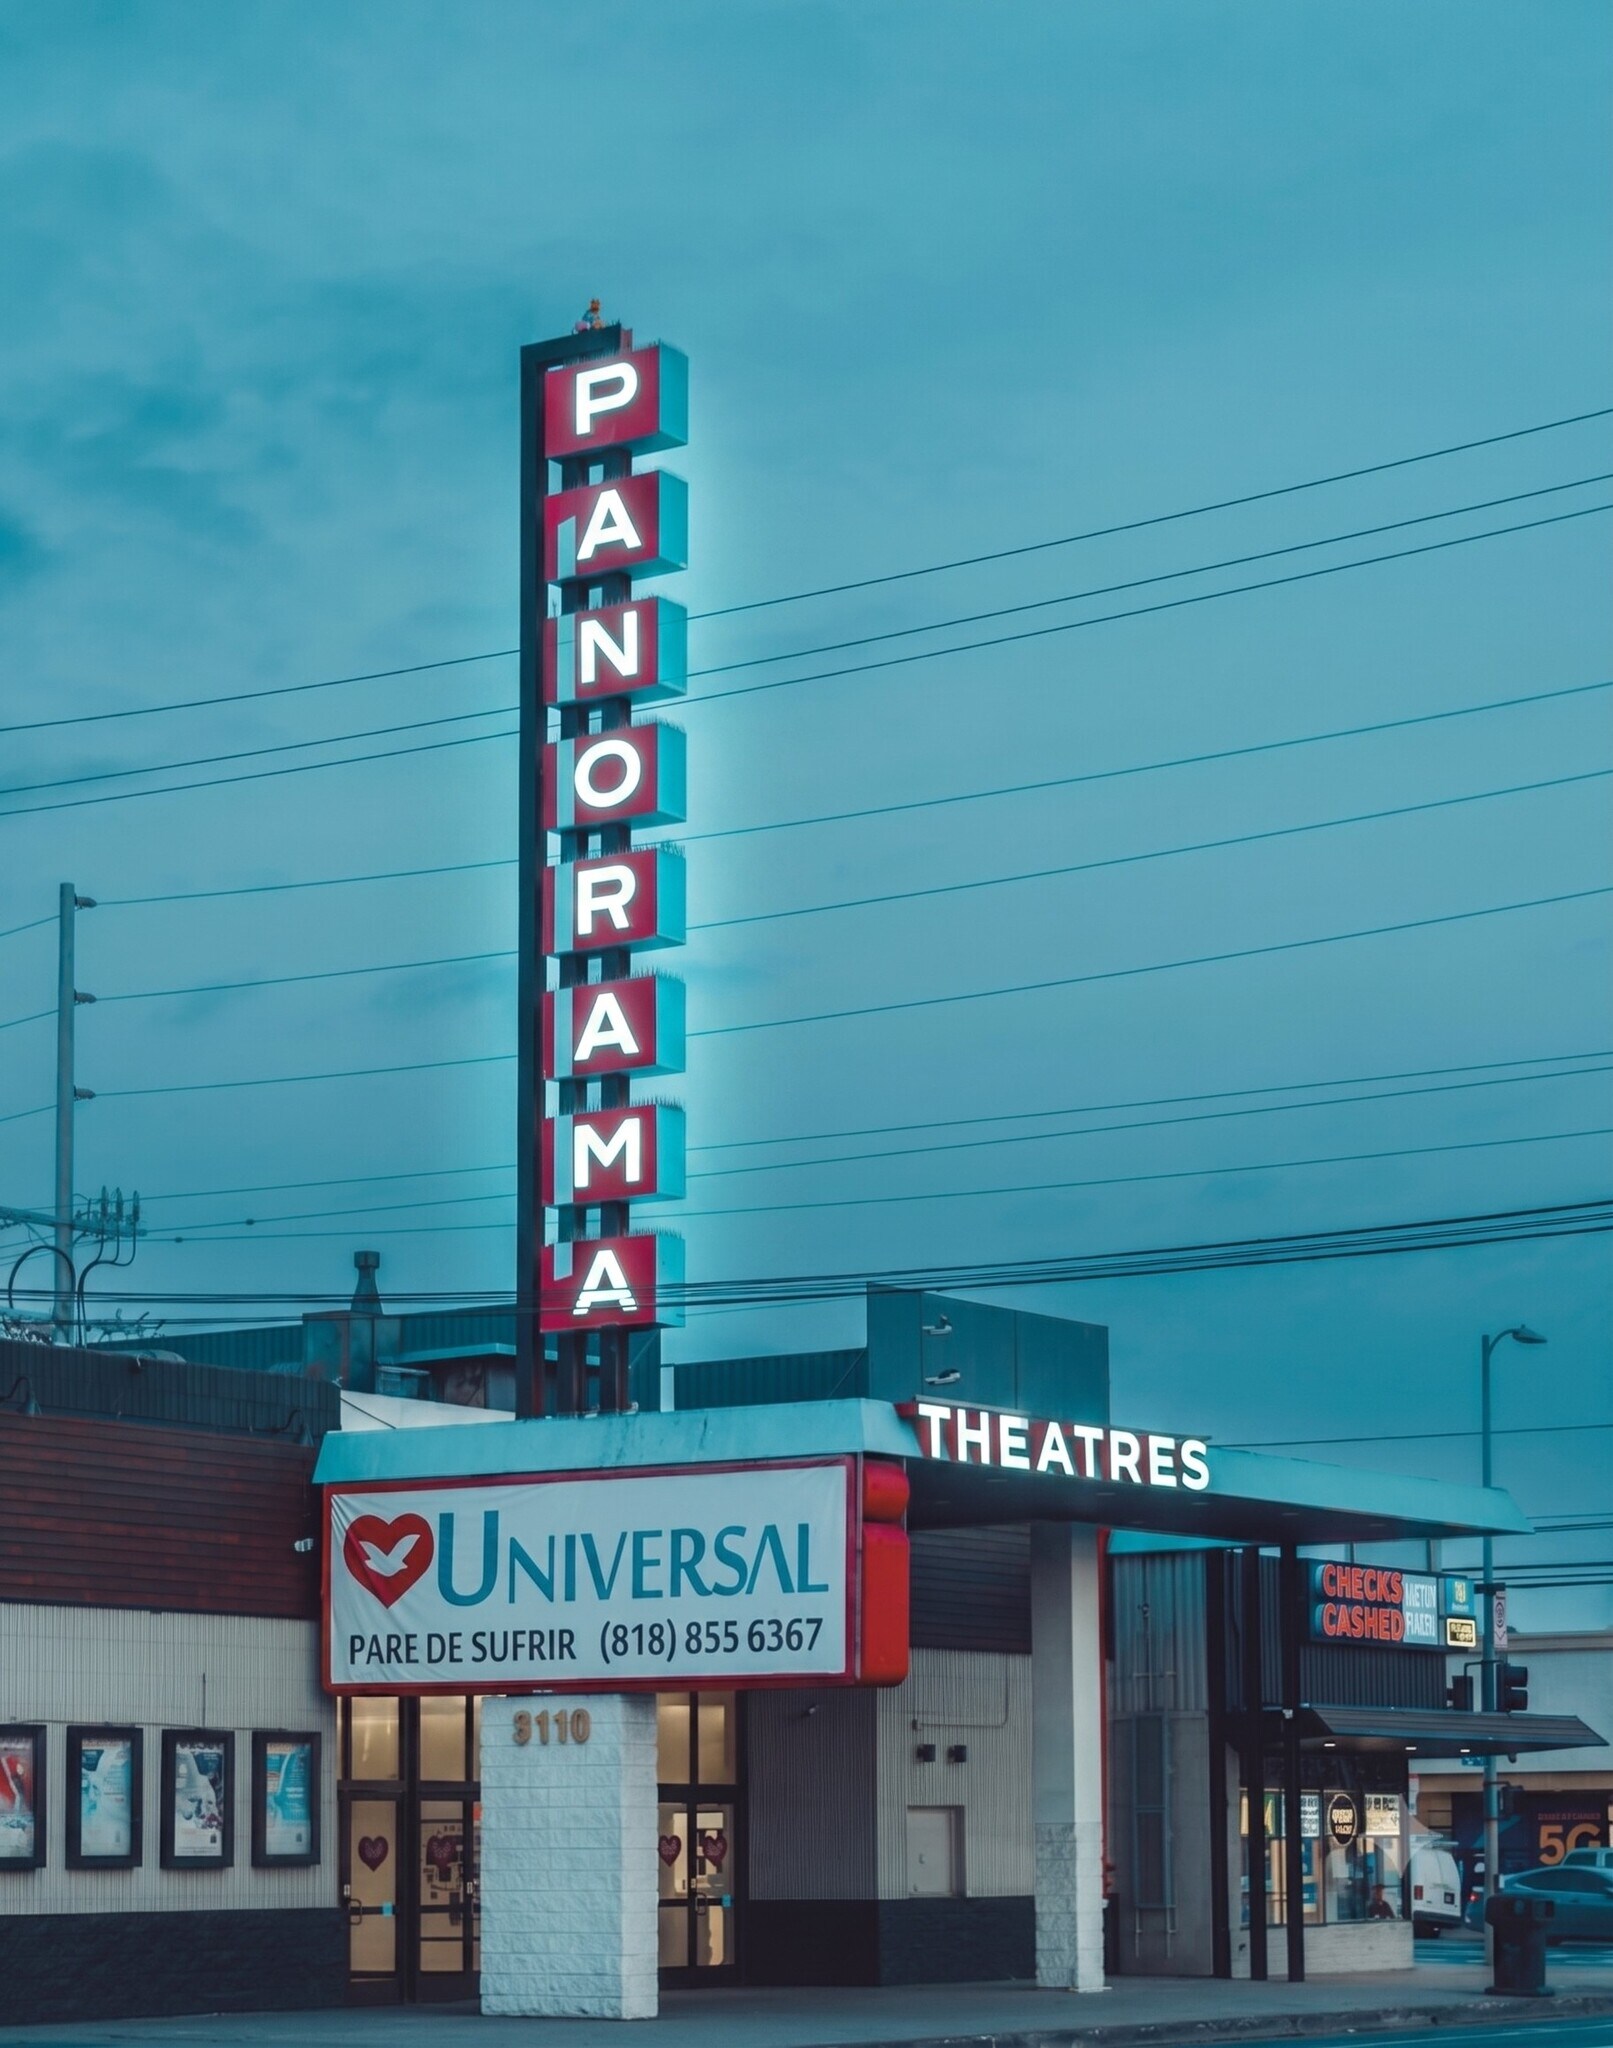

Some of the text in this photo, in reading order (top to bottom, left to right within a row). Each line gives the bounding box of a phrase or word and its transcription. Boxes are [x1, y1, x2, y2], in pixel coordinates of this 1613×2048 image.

[573, 361, 642, 1316] PANORAMA
[918, 1402, 1211, 1491] THEATRES
[437, 1509, 830, 1607] UNIVERSAL
[1322, 1563, 1405, 1605] CHECKS
[349, 1617, 824, 1666] PARE DE SUFRIR (818) 855 6367
[1322, 1602, 1406, 1642] CASHED
[513, 1707, 591, 1747] 3110
[1538, 1822, 1602, 1866] 5G
